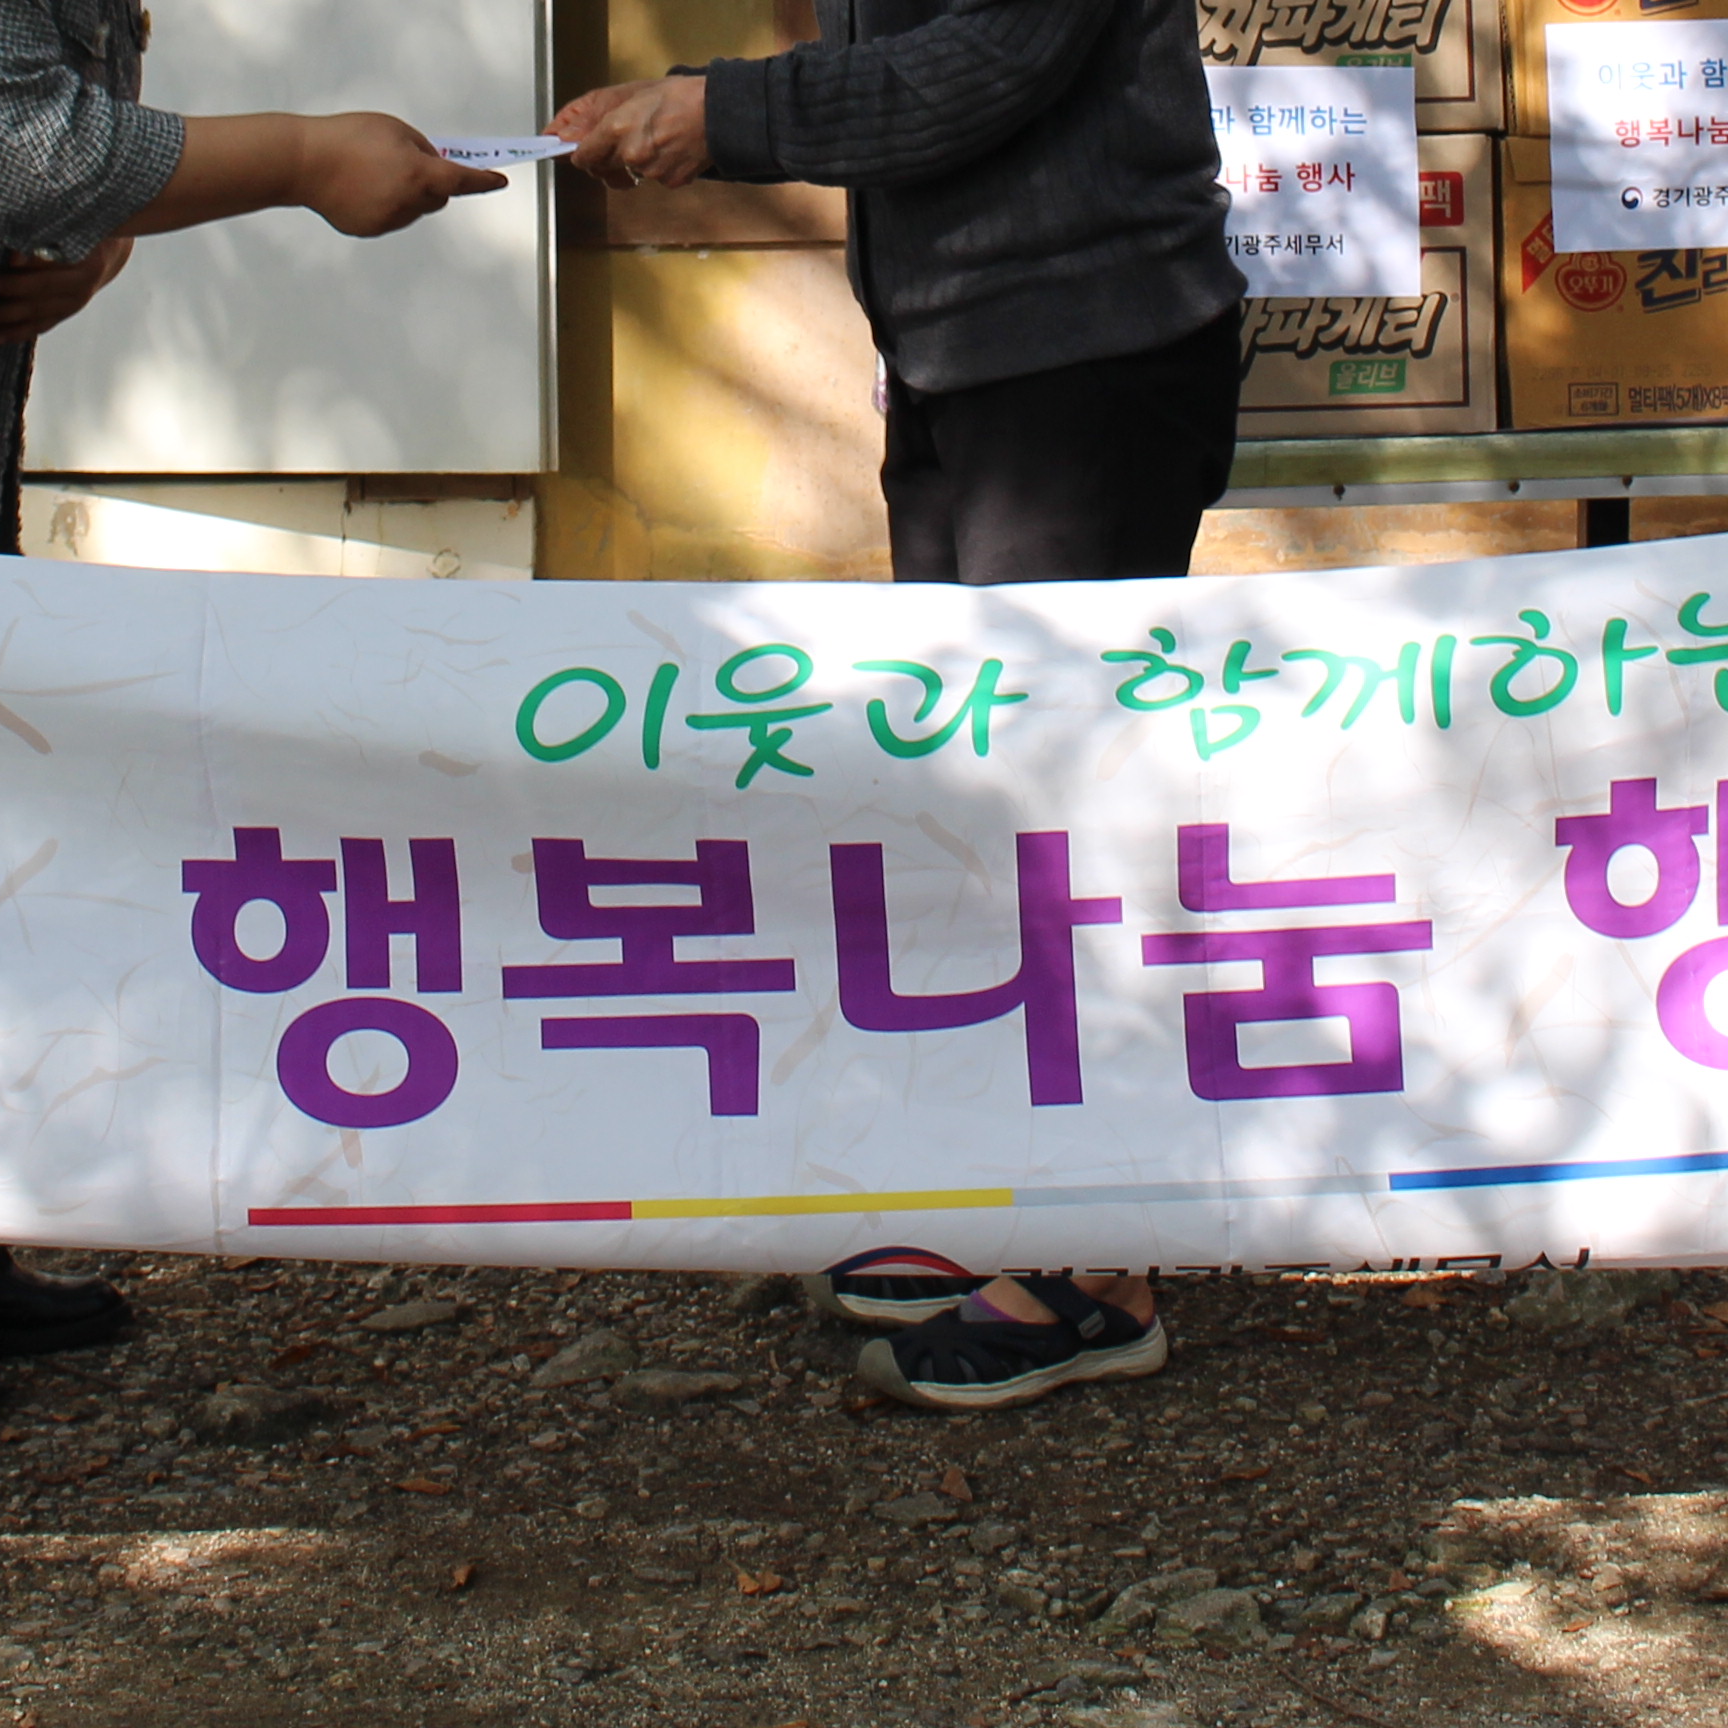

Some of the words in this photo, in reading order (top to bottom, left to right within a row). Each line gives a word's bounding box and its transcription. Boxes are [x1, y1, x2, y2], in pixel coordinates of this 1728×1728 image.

[1598, 59, 1688, 92] 이웃과
[1248, 105, 1368, 136] 함께하는
[1295, 161, 1356, 192] 행사
[1568, 275, 1614, 294] 오뚜기
[1336, 363, 1402, 391] 올리브
[515, 641, 1029, 788] 이웃과
[181, 822, 1435, 1130] 행복나눔
